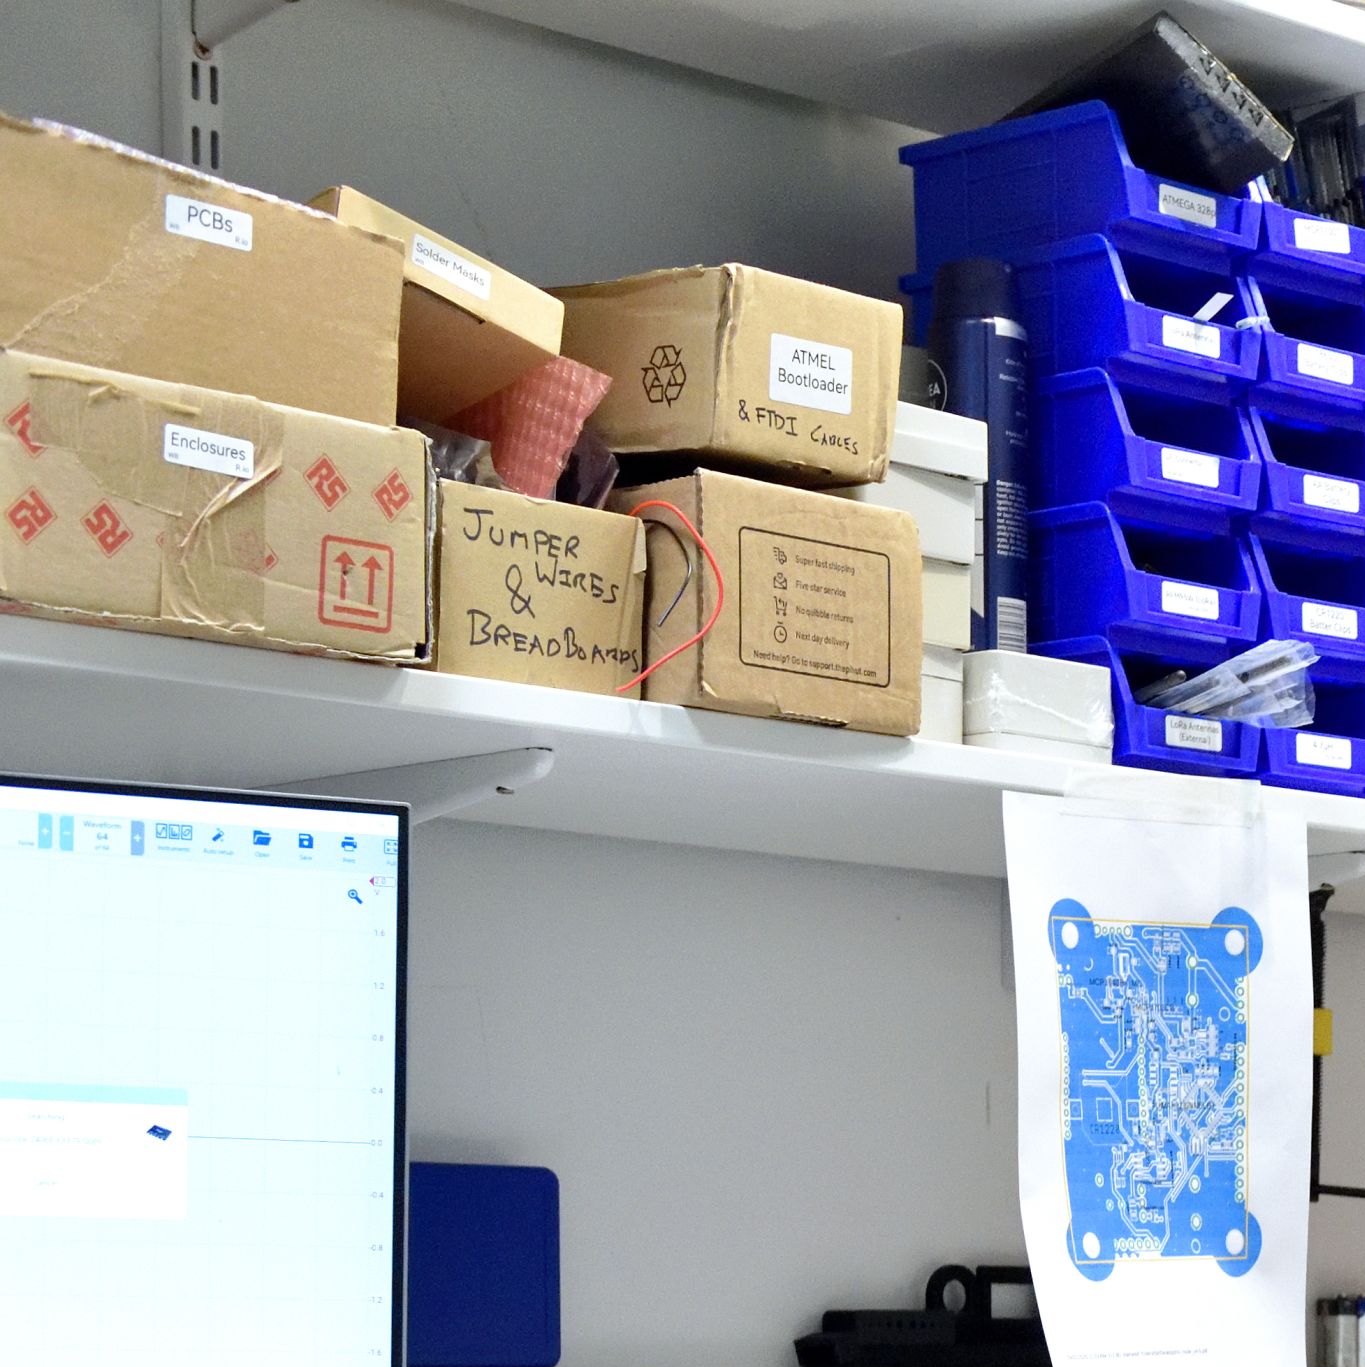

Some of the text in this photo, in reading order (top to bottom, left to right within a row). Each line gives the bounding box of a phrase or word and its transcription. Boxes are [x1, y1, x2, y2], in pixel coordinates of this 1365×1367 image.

[187, 205, 233, 233] PCBs
[415, 242, 485, 287] Solder Masks
[791, 349, 835, 371] ATMEL
[778, 367, 848, 395] Bootloader
[739, 399, 859, 455] & FTDI CABLES
[171, 432, 246, 461] Enclosures
[308, 459, 349, 508] RS
[373, 475, 411, 518] RS
[10, 491, 55, 539] RS
[85, 504, 128, 553] RS
[463, 507, 580, 559] JUMPER
[505, 564, 536, 619] &
[535, 558, 620, 604] WIRES
[823, 586, 847, 598] service
[753, 649, 771, 660] Need
[771, 652, 790, 665] help?
[791, 655, 801, 665] Go
[795, 631, 850, 650] Next day delivery
[1170, 719, 1187, 731] LoRa
[83, 819, 122, 830] Waveform
